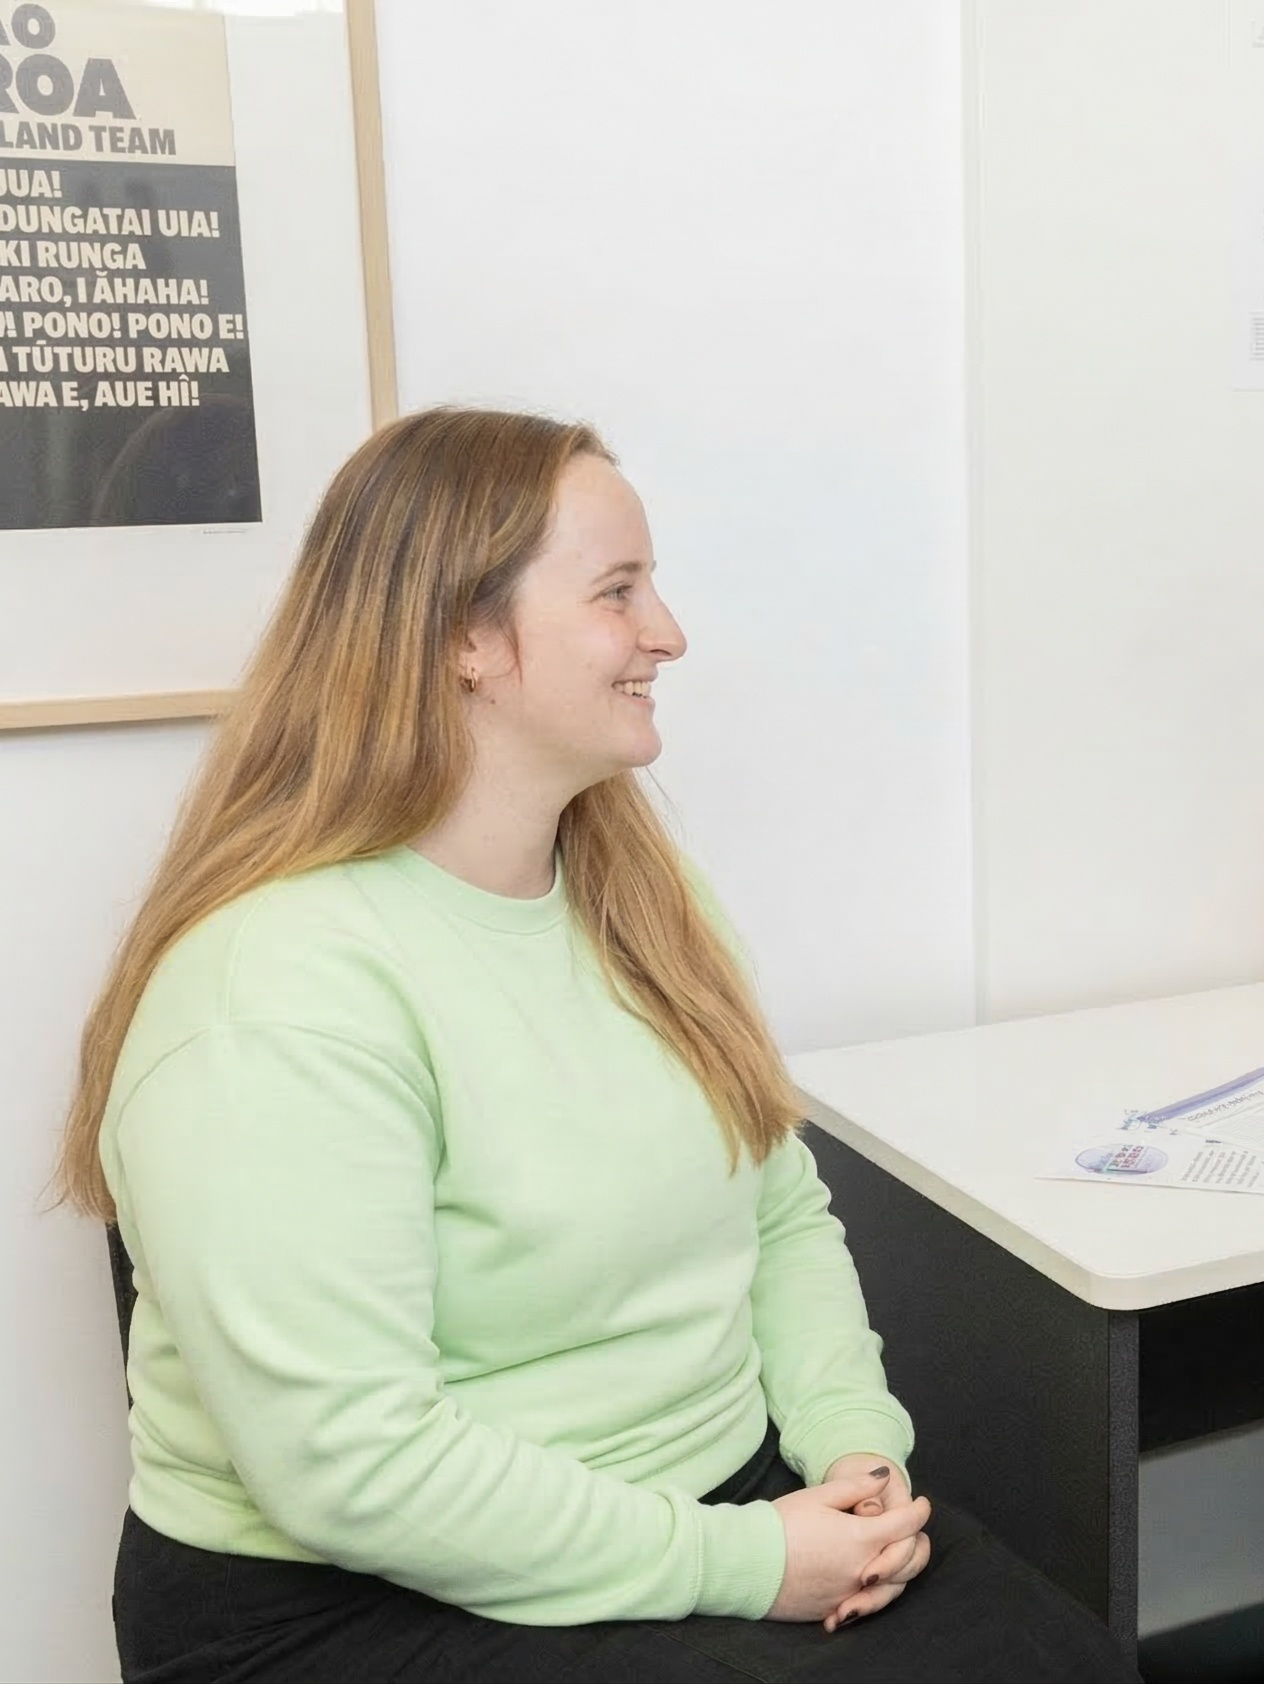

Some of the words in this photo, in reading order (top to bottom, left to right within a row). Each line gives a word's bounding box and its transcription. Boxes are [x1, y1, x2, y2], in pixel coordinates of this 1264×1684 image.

[88, 125, 177, 156] TEAM
[158, 210, 220, 238] UIA!
[36, 240, 147, 270] RUNGA
[76, 277, 88, 303] I
[23, 311, 121, 339] PONO!
[128, 312, 213, 340] PONO
[218, 313, 244, 339] E!
[12, 339, 137, 374] TŪTURU
[142, 346, 230, 373] RAWA
[61, 381, 89, 412] E,
[94, 381, 155, 407] AUE
